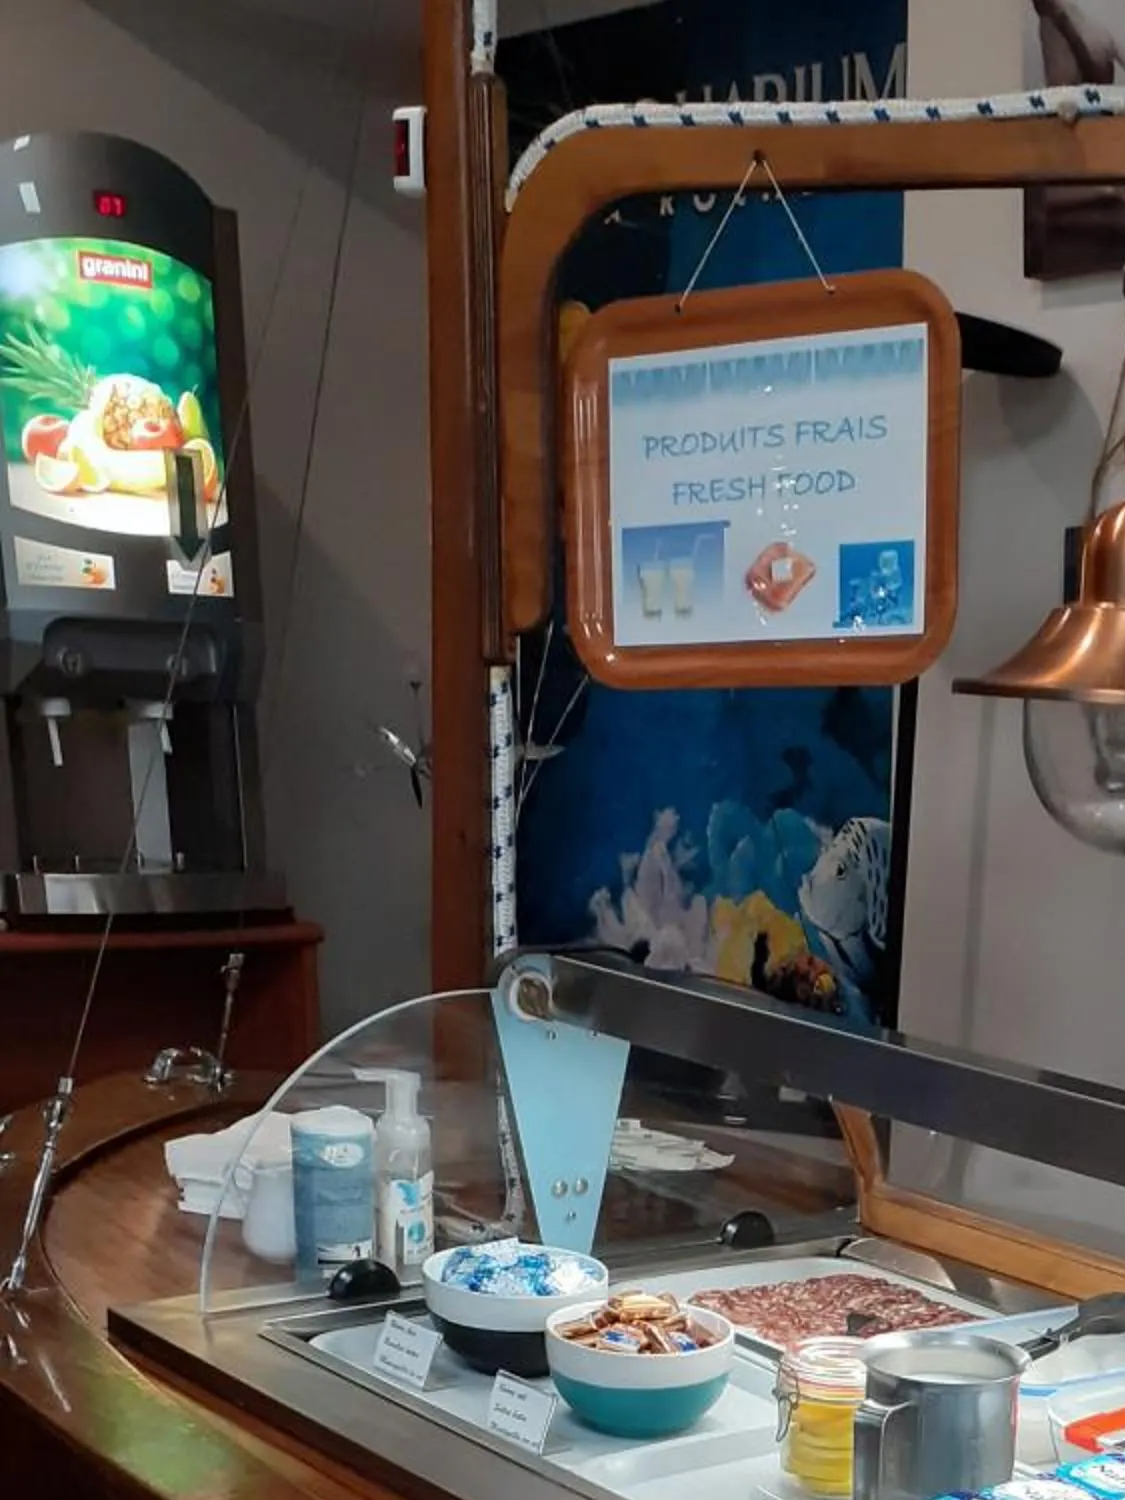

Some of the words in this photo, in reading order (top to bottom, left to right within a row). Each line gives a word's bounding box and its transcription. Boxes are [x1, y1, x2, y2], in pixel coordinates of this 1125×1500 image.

[82, 256, 149, 281] granini
[642, 422, 786, 461] PRODUITS
[795, 414, 888, 445] FRAIS
[673, 475, 767, 506] FRESH
[777, 469, 856, 498] FOOD
